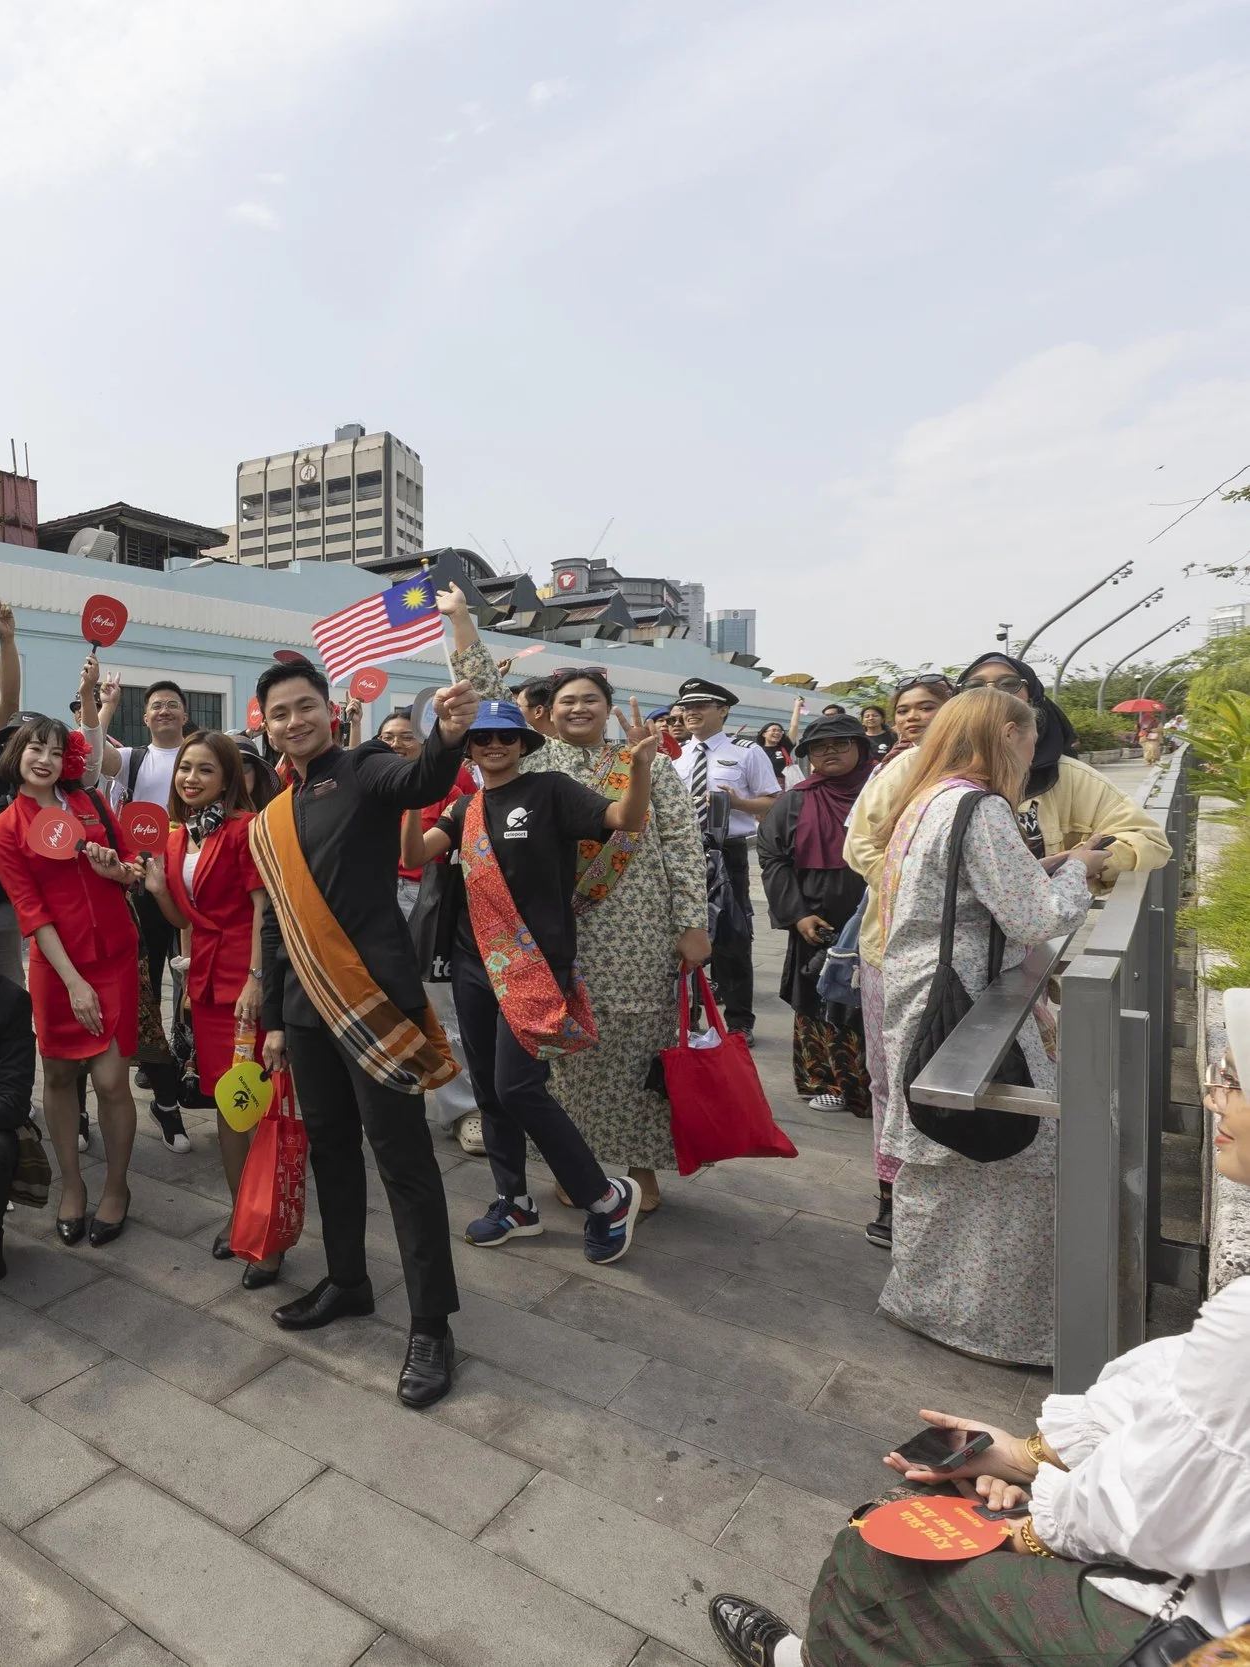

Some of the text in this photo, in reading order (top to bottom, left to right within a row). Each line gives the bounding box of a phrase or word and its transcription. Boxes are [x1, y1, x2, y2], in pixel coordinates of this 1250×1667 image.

[92, 614, 115, 627] AirAsia
[49, 822, 64, 848] AirAsia
[133, 823, 158, 836] AirAsia
[900, 1511, 955, 1550] Kyut Skin
[910, 1501, 980, 1550] In Your Area
